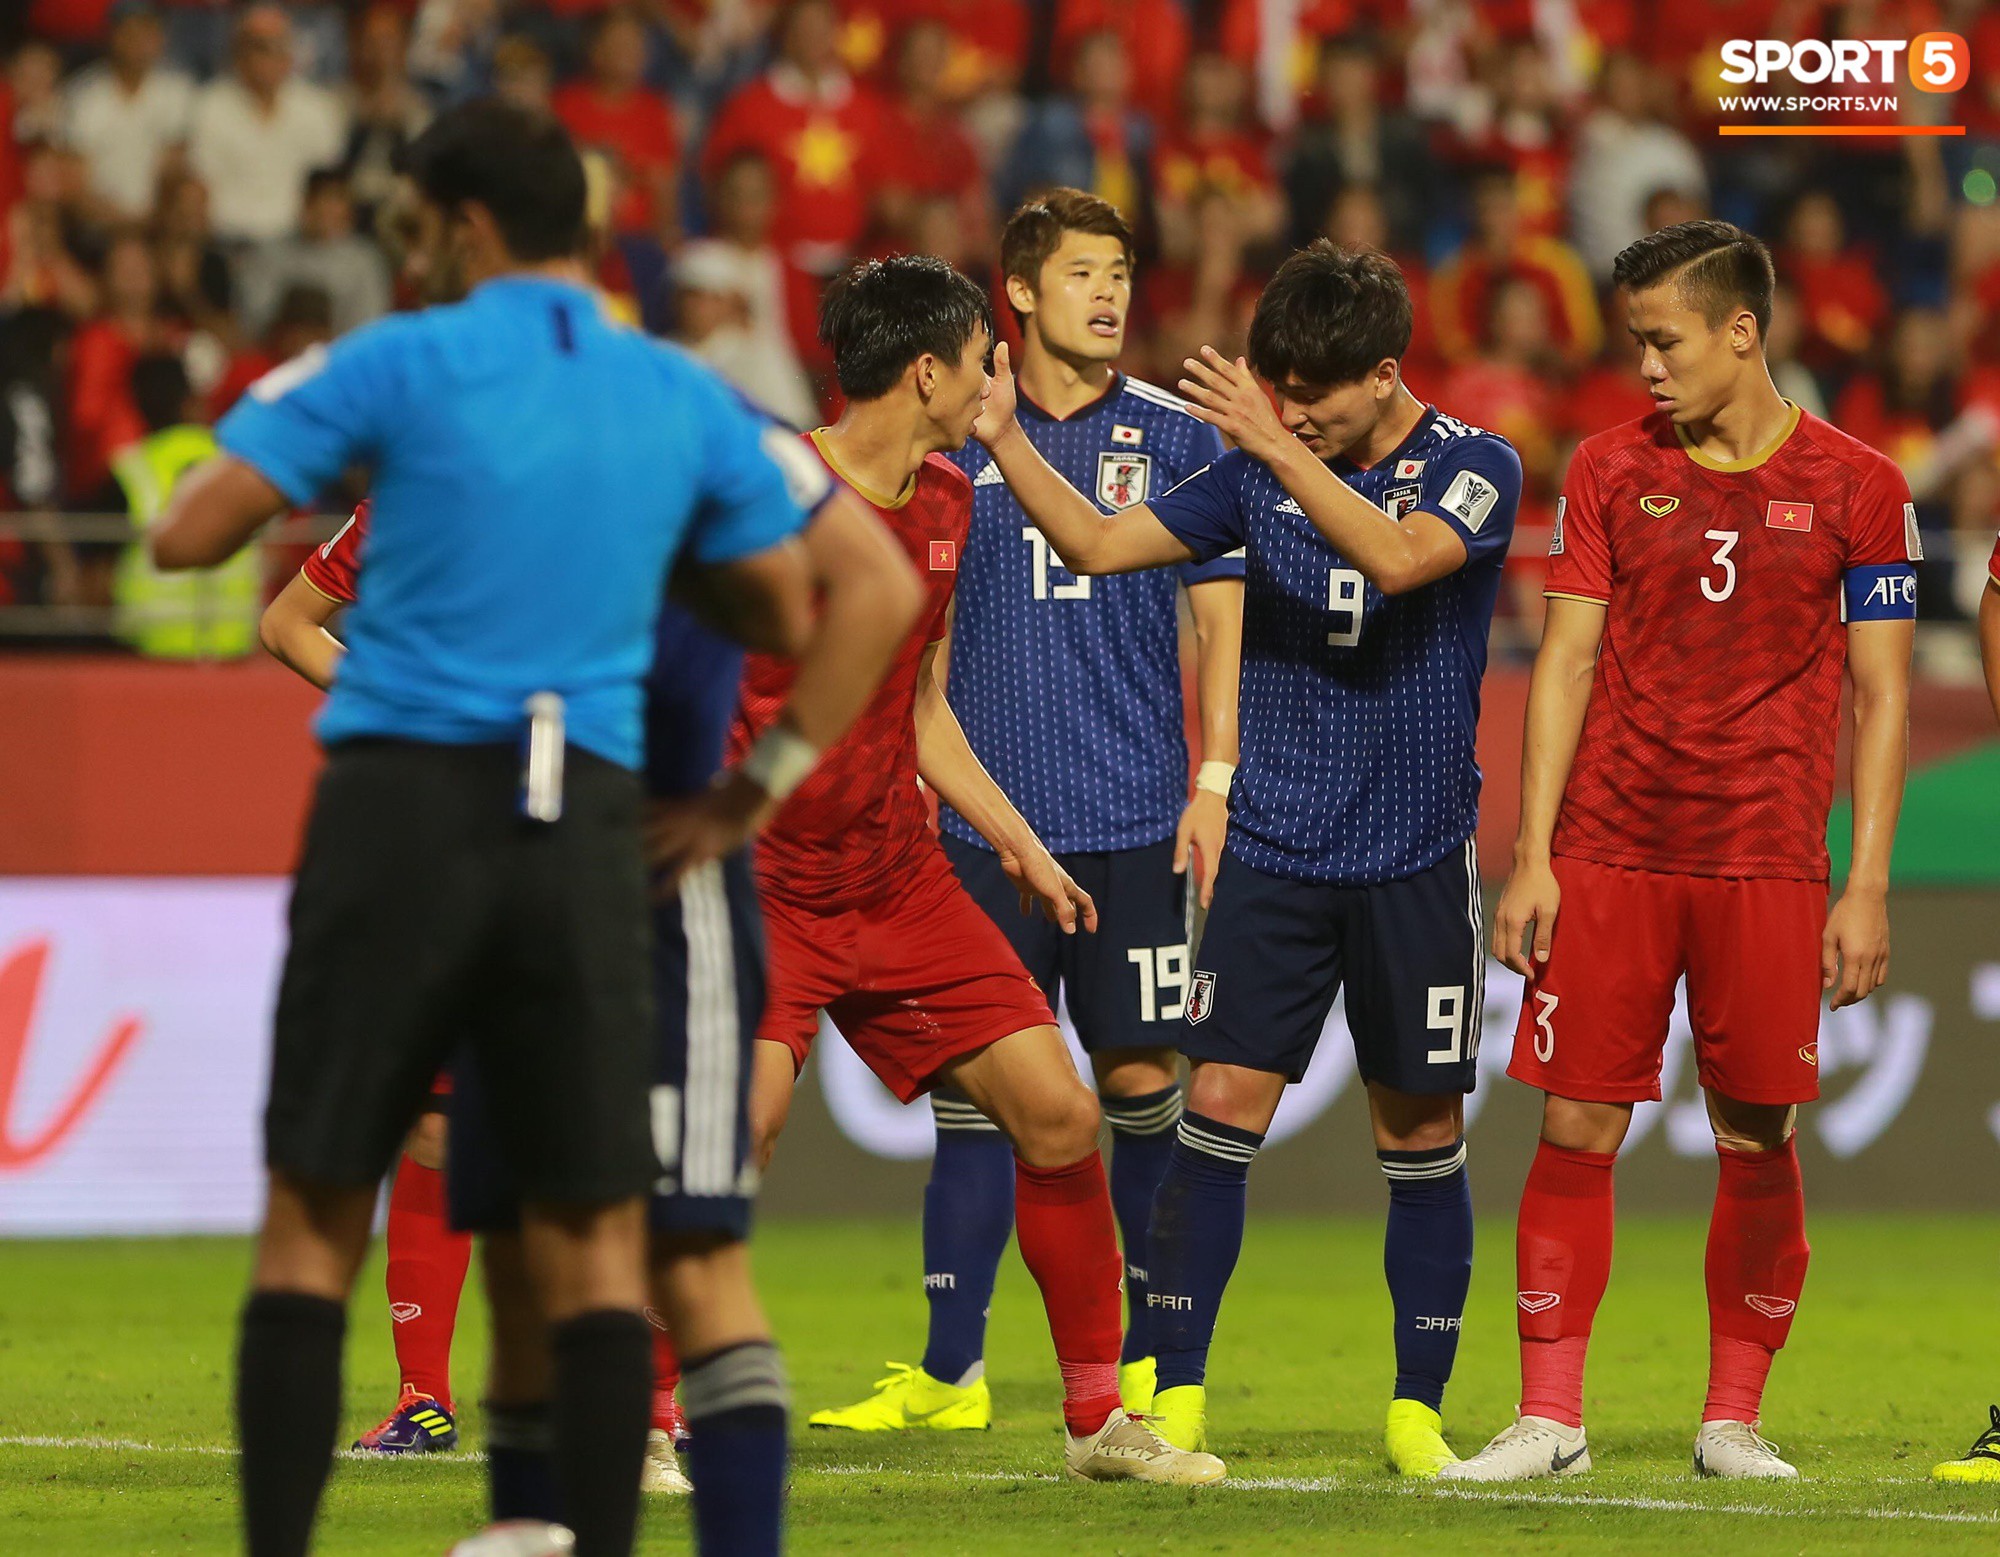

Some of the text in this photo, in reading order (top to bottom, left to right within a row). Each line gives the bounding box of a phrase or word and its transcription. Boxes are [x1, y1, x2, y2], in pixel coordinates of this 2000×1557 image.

[1392, 489, 1411, 498] JAPAN
[1700, 529, 1740, 602] 3
[1863, 575, 1917, 606] AFC
[1327, 568, 1365, 647] 9
[1127, 944, 1188, 1022] 19
[1426, 985, 1465, 1063] 9
[1533, 989, 1559, 1063] 3
